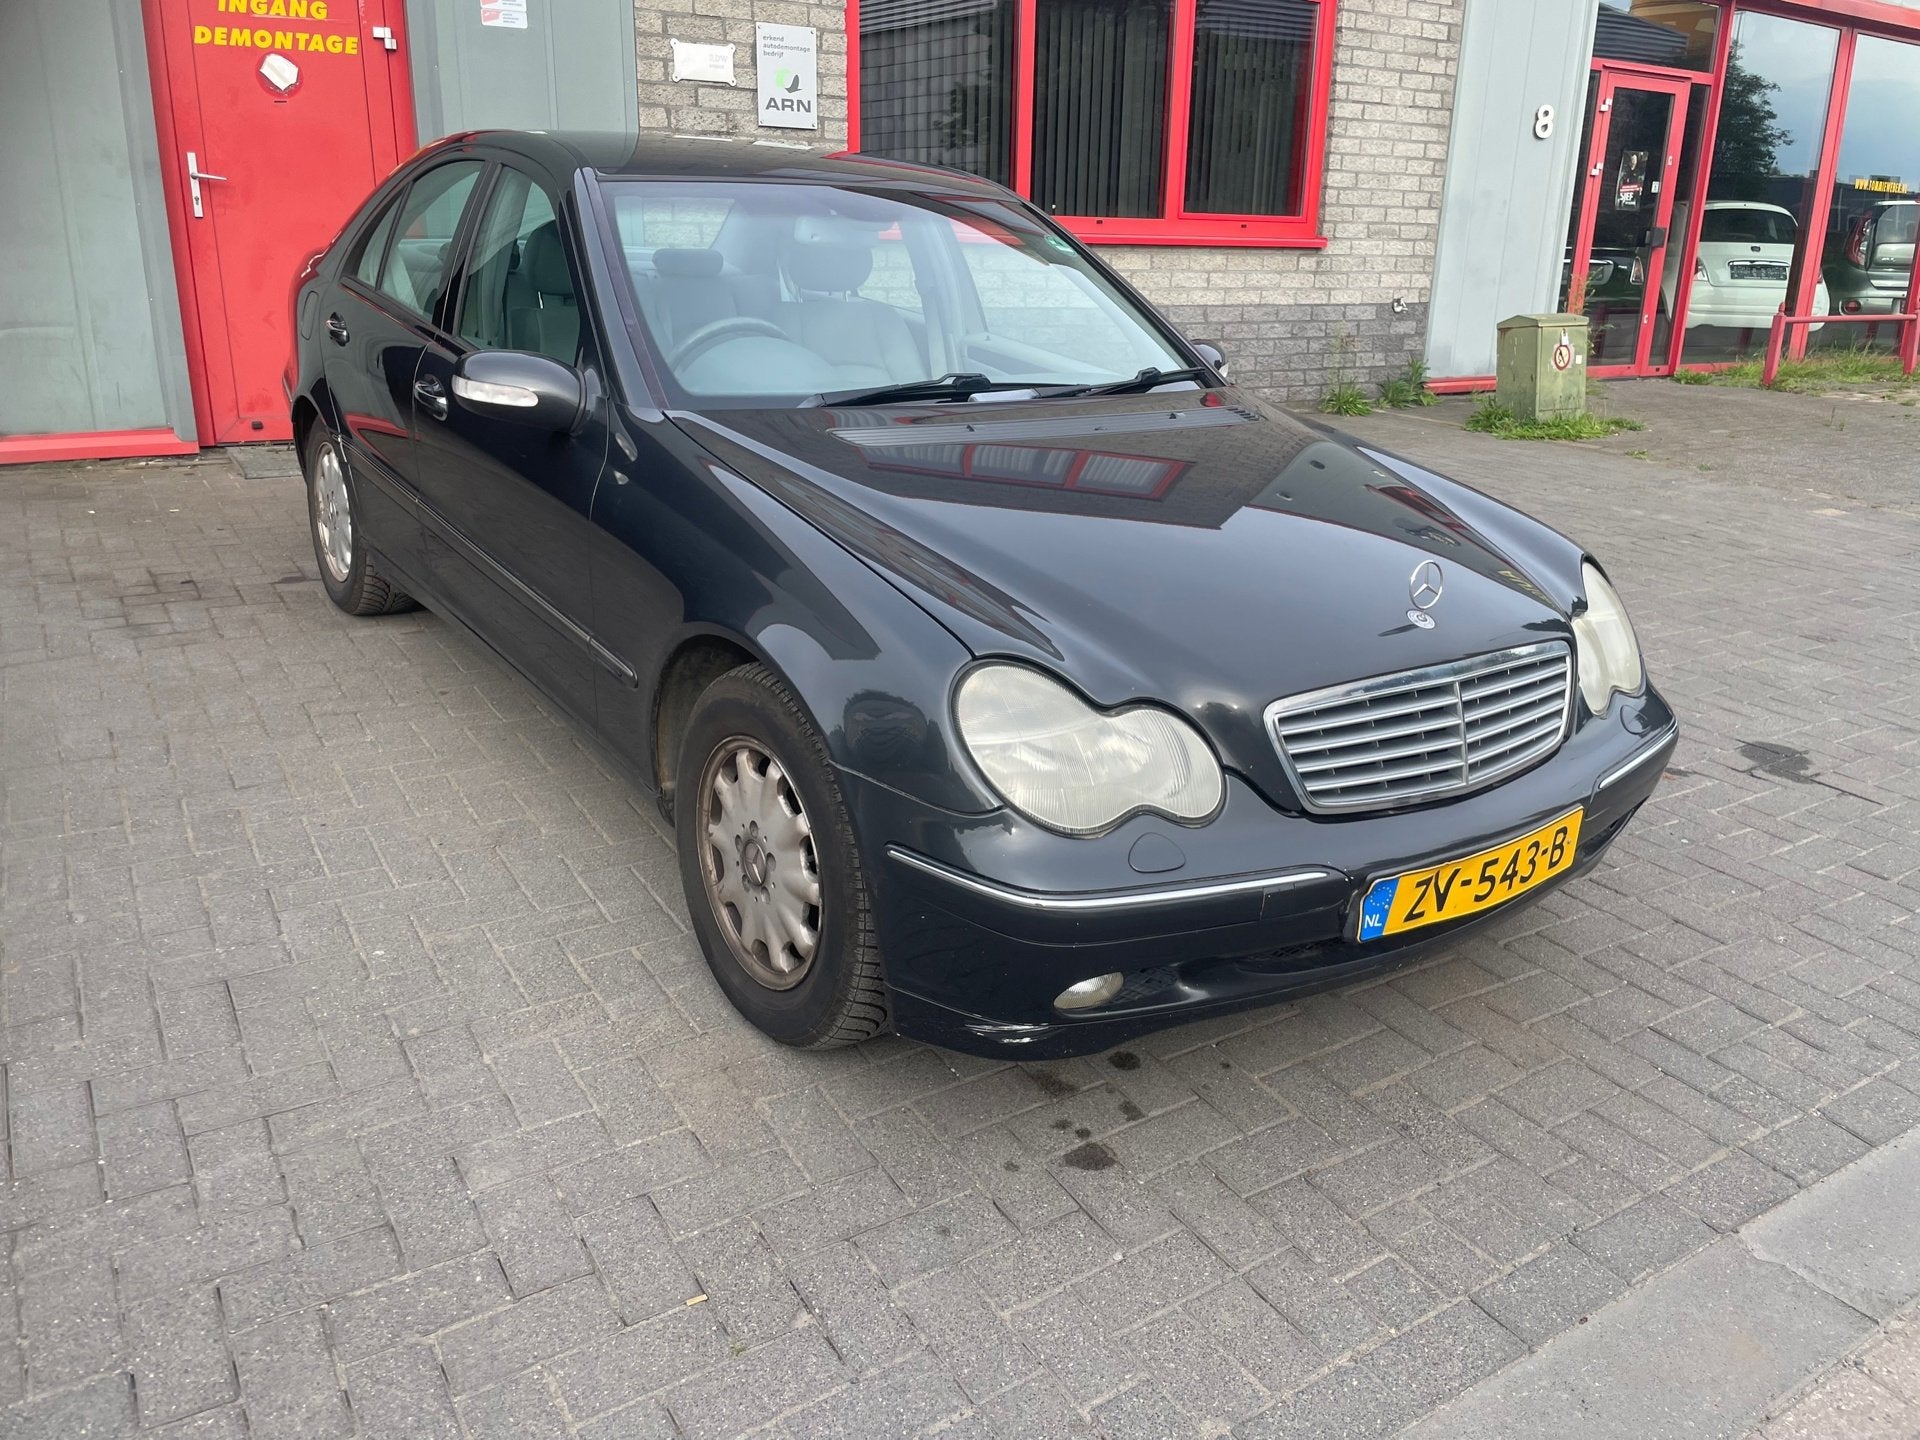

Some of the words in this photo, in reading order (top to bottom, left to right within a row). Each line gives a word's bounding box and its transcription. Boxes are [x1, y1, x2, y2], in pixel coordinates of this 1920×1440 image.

[217, 0, 328, 20] INGANG
[193, 25, 359, 55] DEMONTAGE
[762, 43, 811, 53] autodemontage
[763, 50, 784, 59] bedrijf
[765, 97, 811, 113] ARN
[1535, 104, 1554, 139] 8
[1403, 826, 1568, 923] ZV-543-B
[1364, 914, 1382, 929] NL
